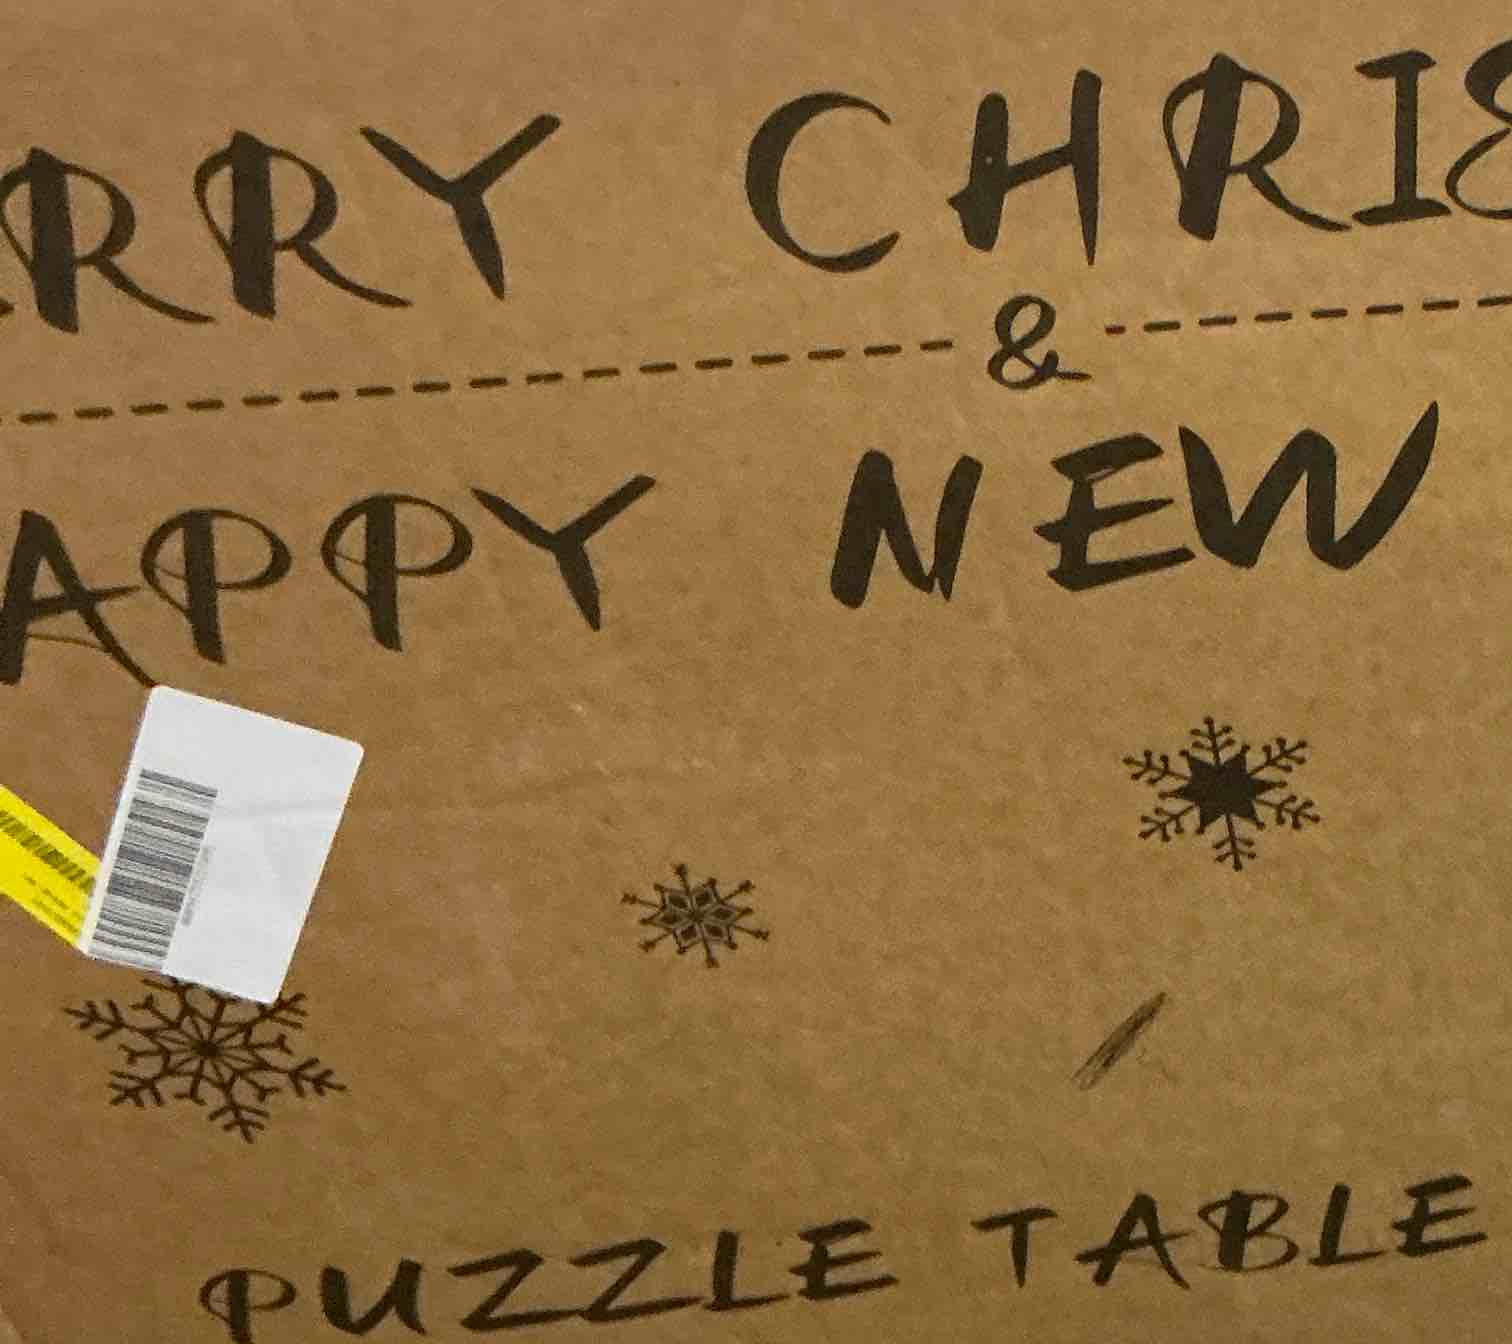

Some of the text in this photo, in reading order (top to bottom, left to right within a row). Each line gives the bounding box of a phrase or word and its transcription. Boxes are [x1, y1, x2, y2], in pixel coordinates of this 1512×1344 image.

[0, 113, 561, 335] RRY
[987, 295, 1092, 390] &
[830, 400, 1440, 610] NEW
[970, 1174, 1489, 1290] TABLE
